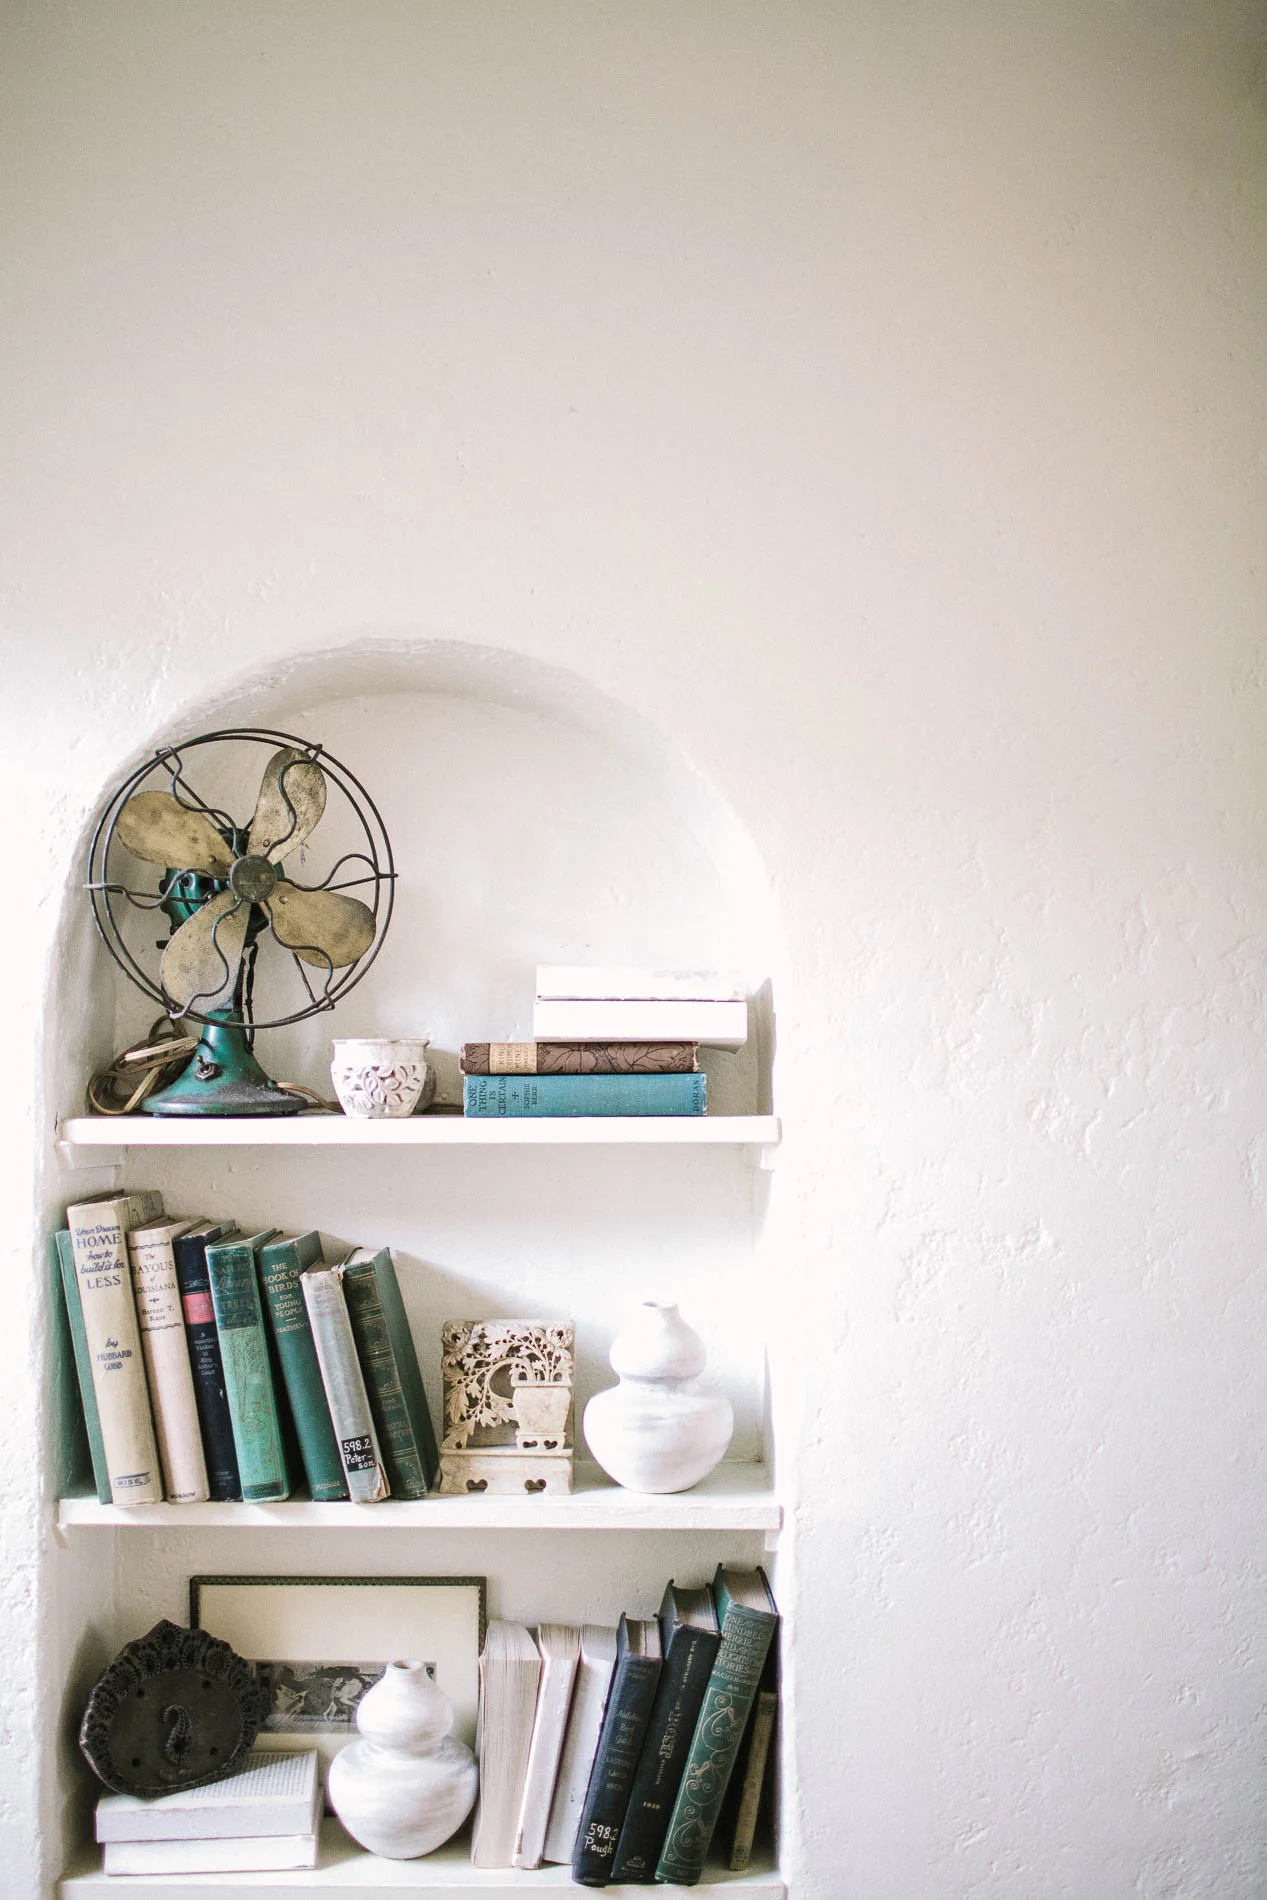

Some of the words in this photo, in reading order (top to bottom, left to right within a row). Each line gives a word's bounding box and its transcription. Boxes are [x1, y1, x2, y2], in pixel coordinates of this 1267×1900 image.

[469, 1085, 477, 1107] ONE
[478, 1080, 487, 1112] THING
[489, 1090, 496, 1100] IS
[498, 1076, 506, 1115] CERTAIN
[692, 1079, 700, 1112] DORAN
[76, 1233, 122, 1248] HOME
[88, 1251, 104, 1260] how
[104, 1250, 113, 1258] to
[80, 1262, 105, 1274] build
[105, 1260, 113, 1271] it
[271, 1263, 288, 1271] THE
[87, 1275, 121, 1290] LESS
[268, 1281, 299, 1293] BIRDS
[274, 1300, 301, 1310] YOUNG
[105, 1337, 118, 1348] by
[343, 1438, 372, 1453] 598.2
[725, 1613, 742, 1626] ONE
[588, 1823, 619, 1841] 598.2
[584, 1835, 613, 1857] Pough
